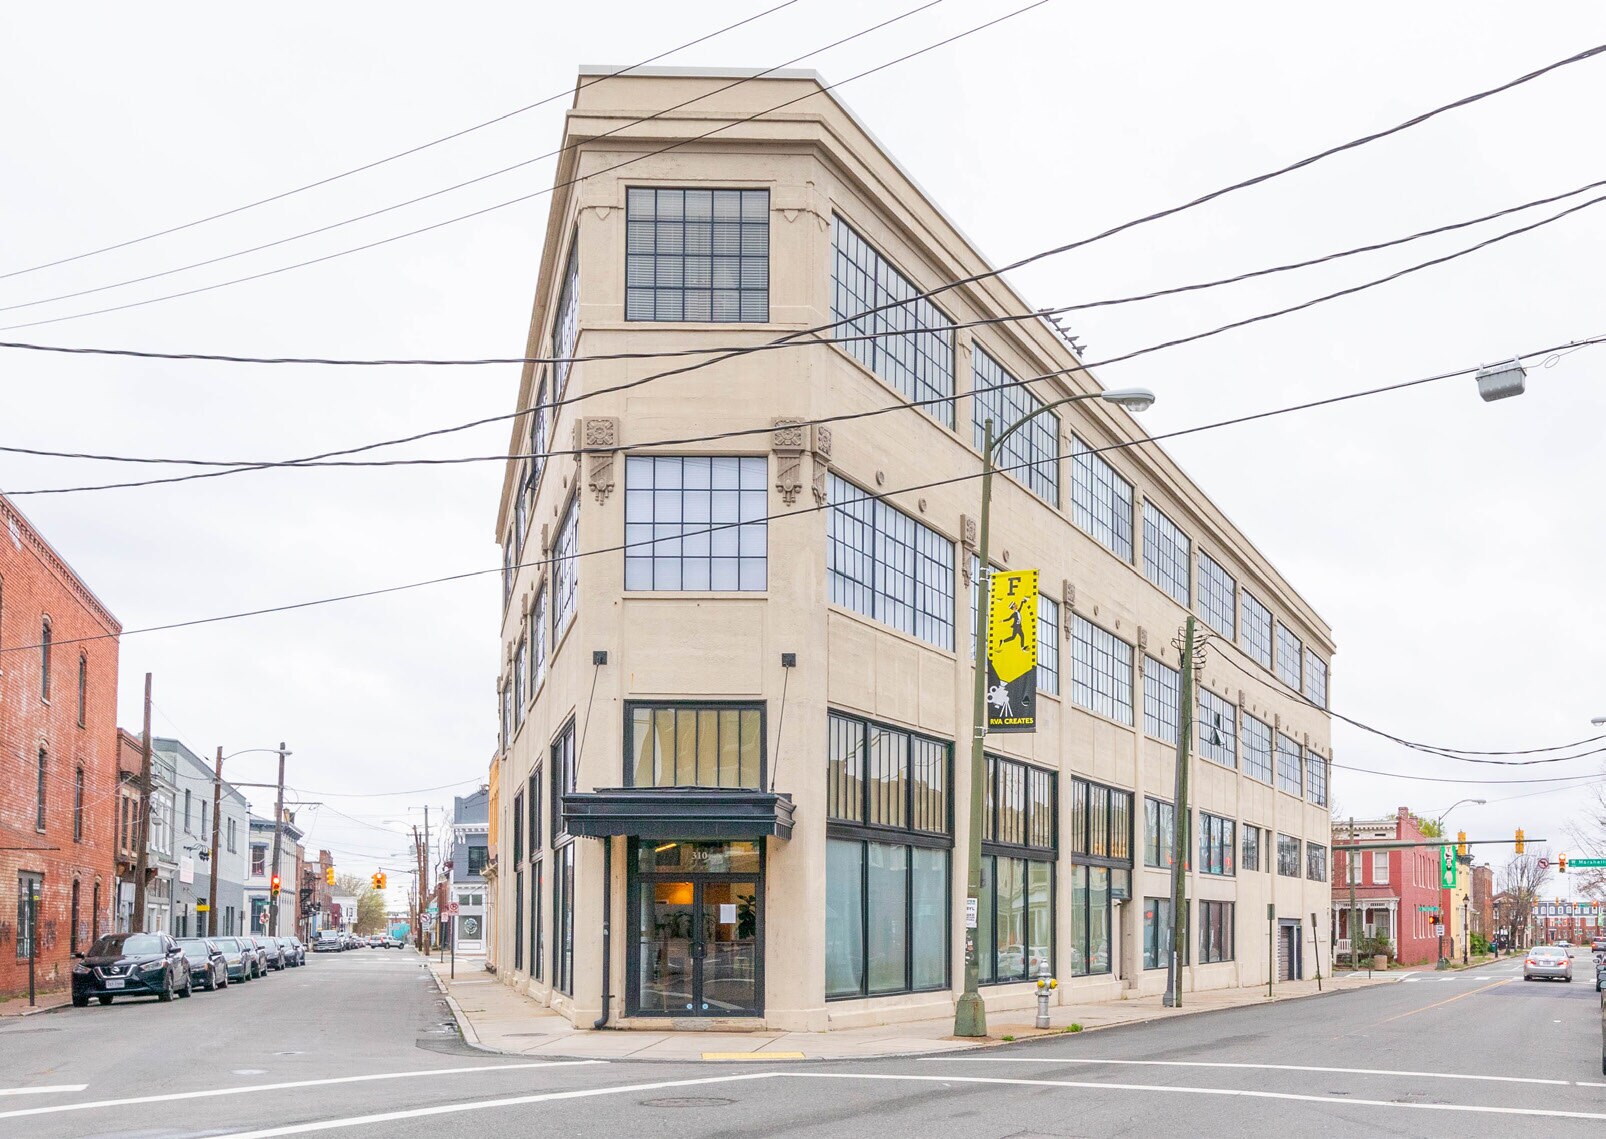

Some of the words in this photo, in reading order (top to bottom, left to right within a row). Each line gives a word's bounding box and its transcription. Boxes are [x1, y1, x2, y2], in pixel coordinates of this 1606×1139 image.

[1007, 576, 1021, 596] F
[990, 717, 1003, 725] RVA
[1004, 717, 1034, 725] CREATES
[692, 851, 708, 860] 310
